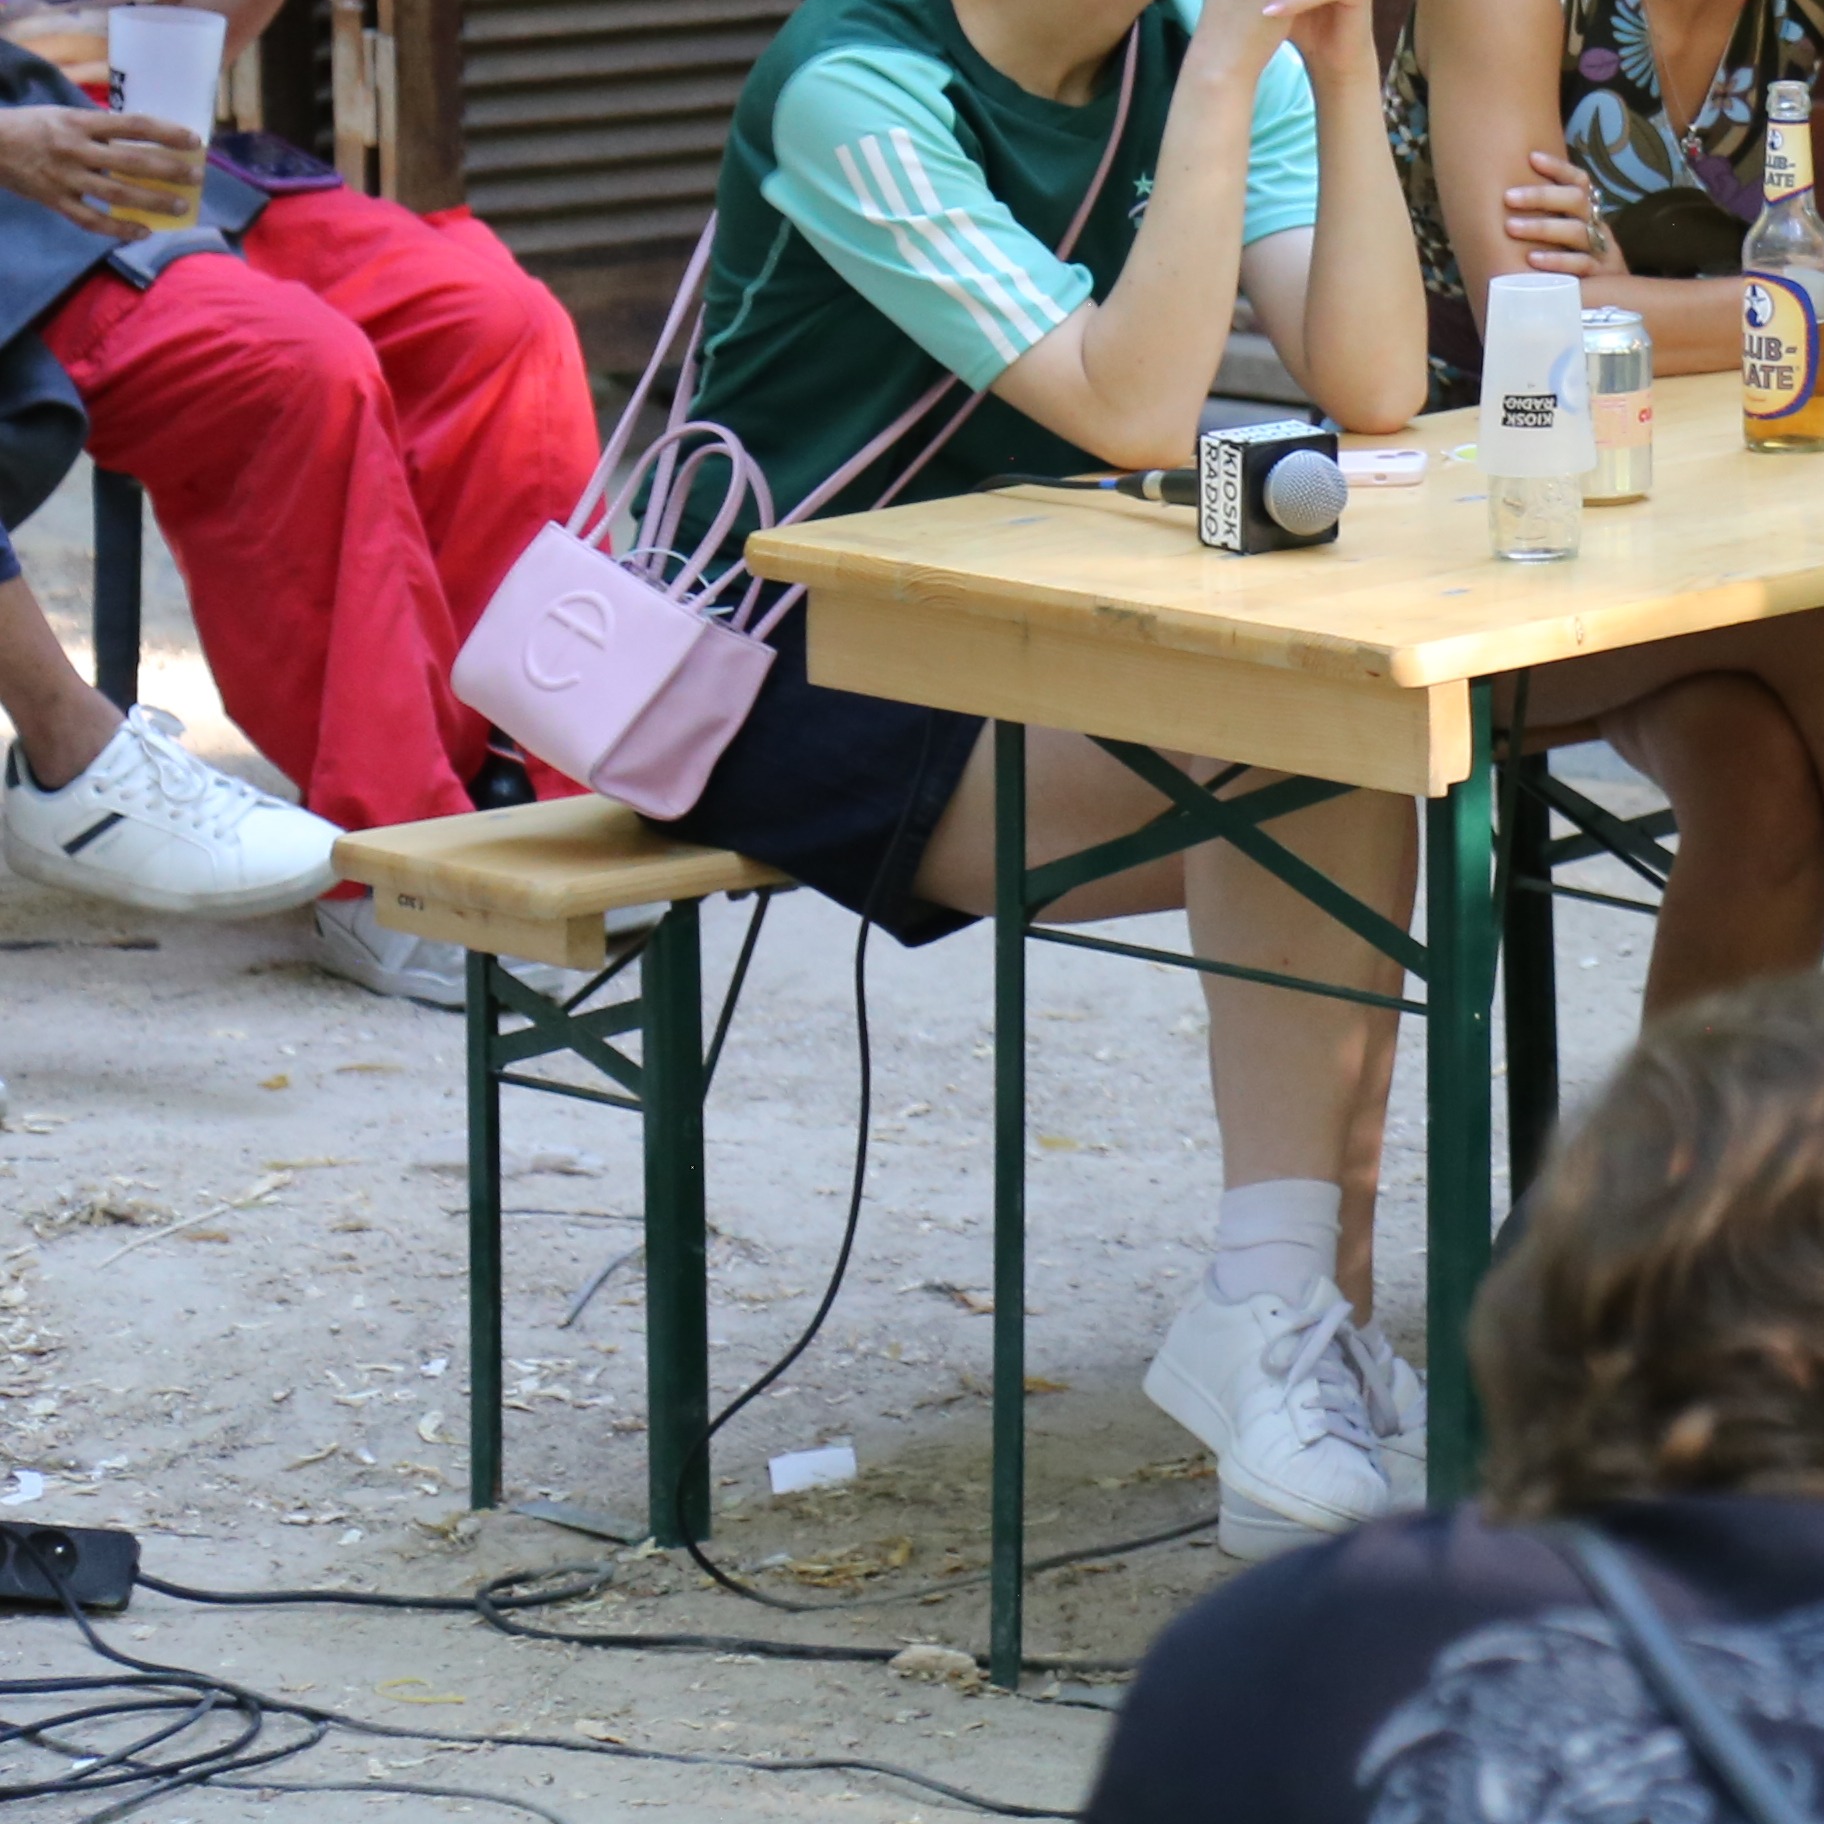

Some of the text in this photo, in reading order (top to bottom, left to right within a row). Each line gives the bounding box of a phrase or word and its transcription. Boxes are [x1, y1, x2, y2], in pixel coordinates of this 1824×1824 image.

[1765, 172, 1795, 188] ATE
[1744, 363, 1795, 390] ATE
[1505, 397, 1556, 411] RADIO
[1506, 412, 1554, 426] KIOSK
[1204, 441, 1219, 537] RADIO
[1222, 447, 1238, 540] KIOSK
